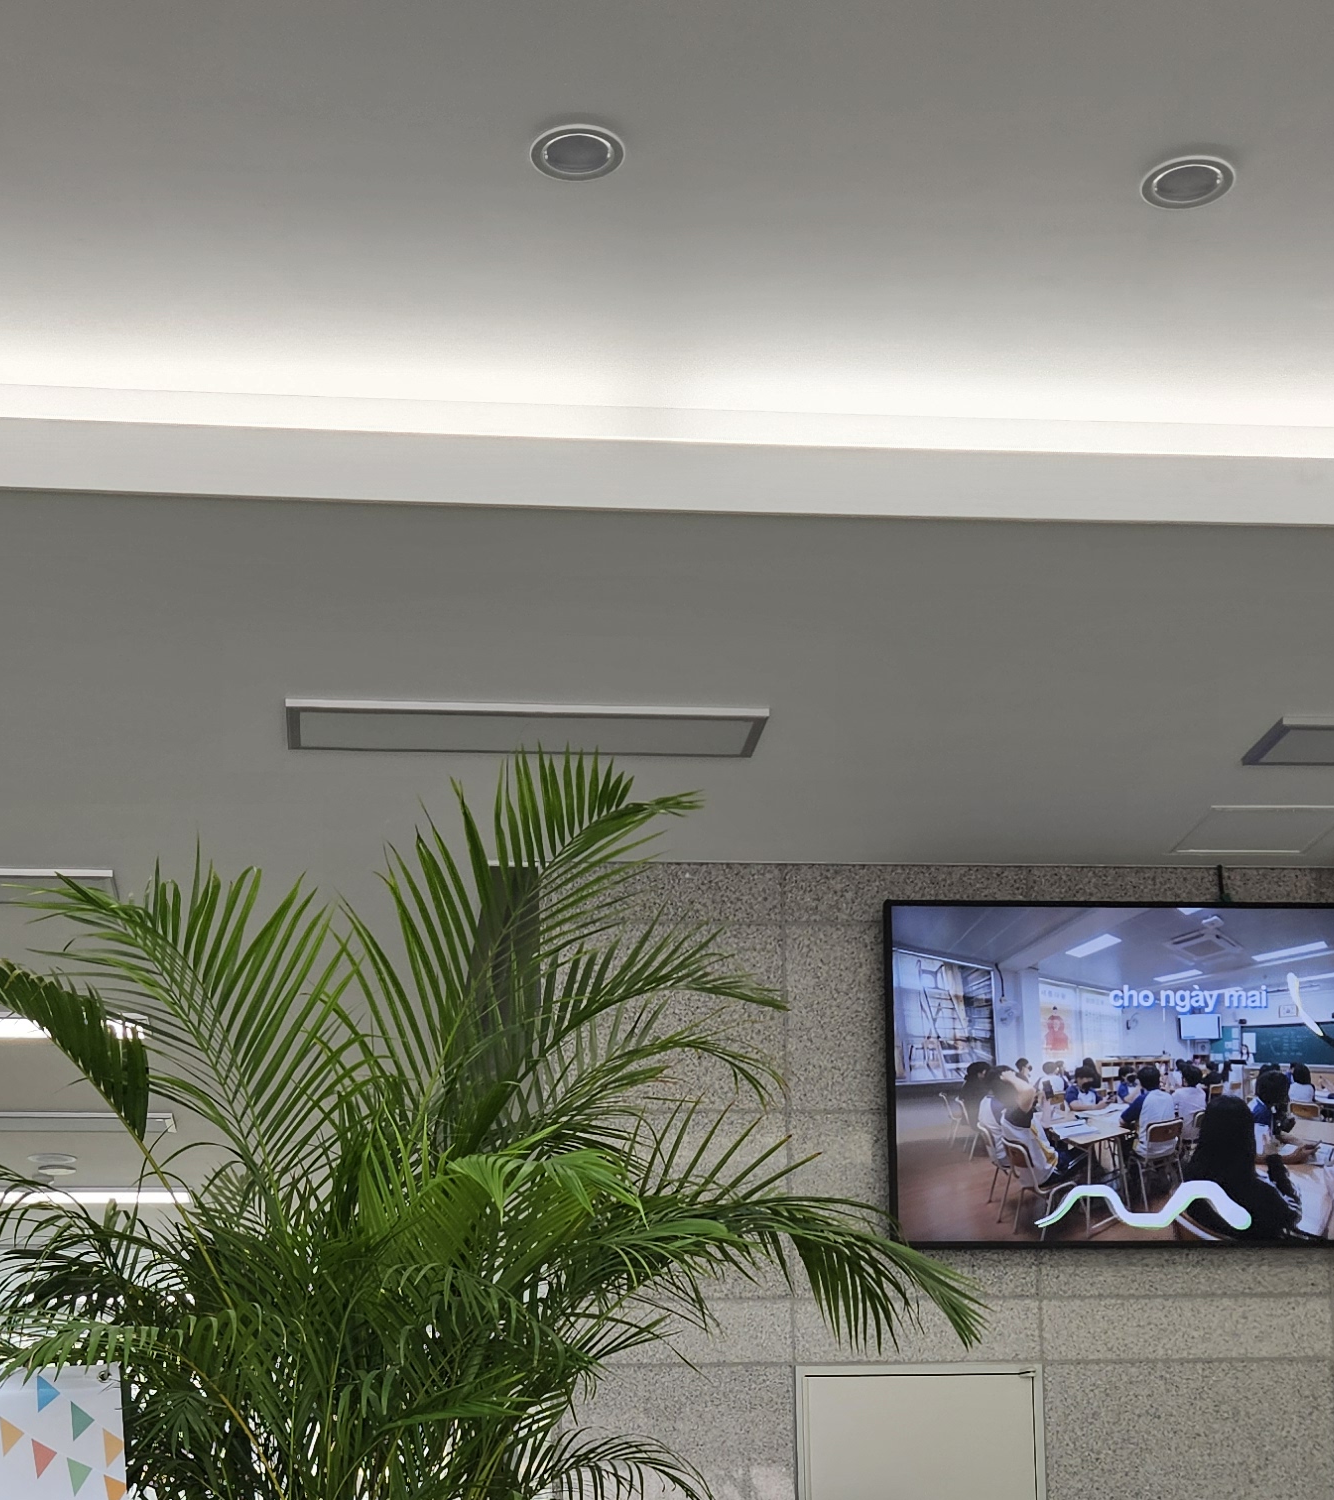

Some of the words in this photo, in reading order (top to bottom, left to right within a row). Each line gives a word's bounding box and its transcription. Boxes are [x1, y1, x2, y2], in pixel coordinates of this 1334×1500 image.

[1109, 985, 1156, 1009] cho
[1160, 985, 1219, 1013] ngày
[1225, 985, 1268, 1009] mai
